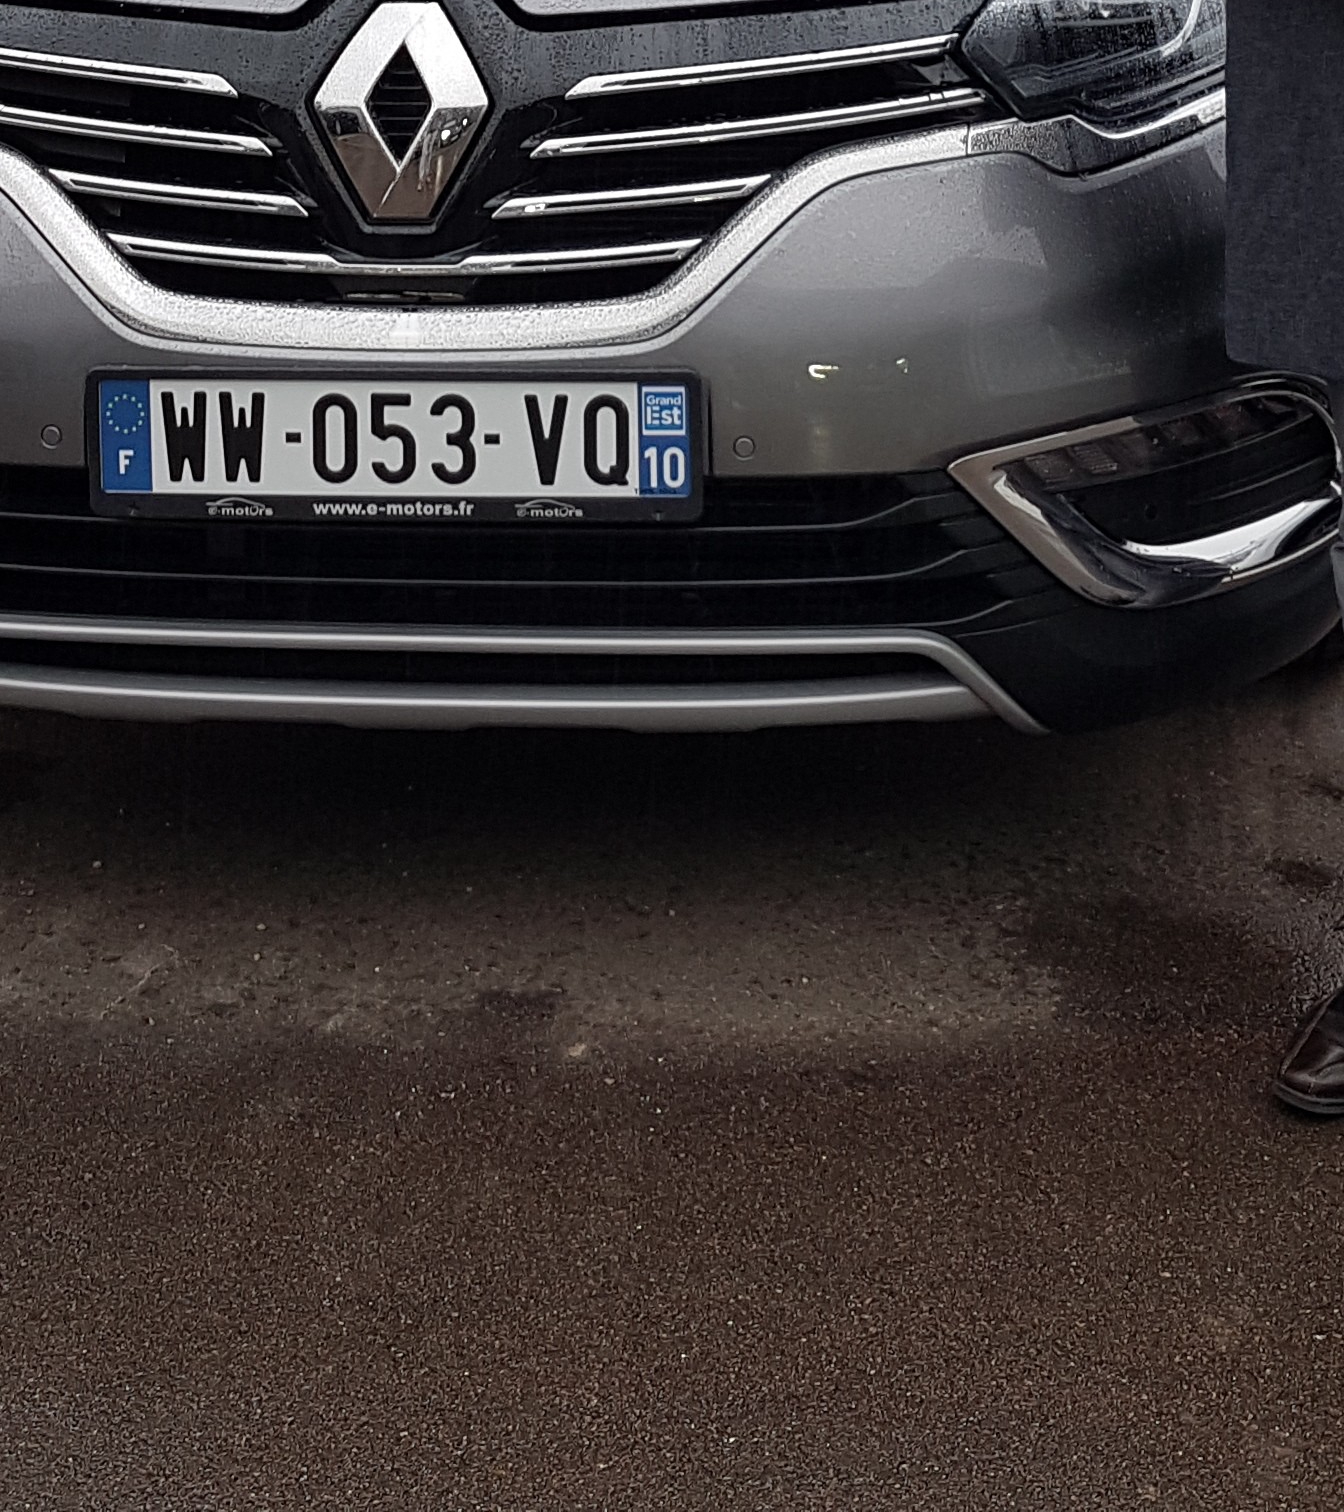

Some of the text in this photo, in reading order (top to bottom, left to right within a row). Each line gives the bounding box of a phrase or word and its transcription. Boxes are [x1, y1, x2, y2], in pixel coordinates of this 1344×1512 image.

[646, 394, 682, 406] Grand
[646, 406, 682, 425] Est
[118, 449, 134, 475] F
[644, 446, 686, 489] 10
[312, 500, 475, 517] www.e-motors.fr
